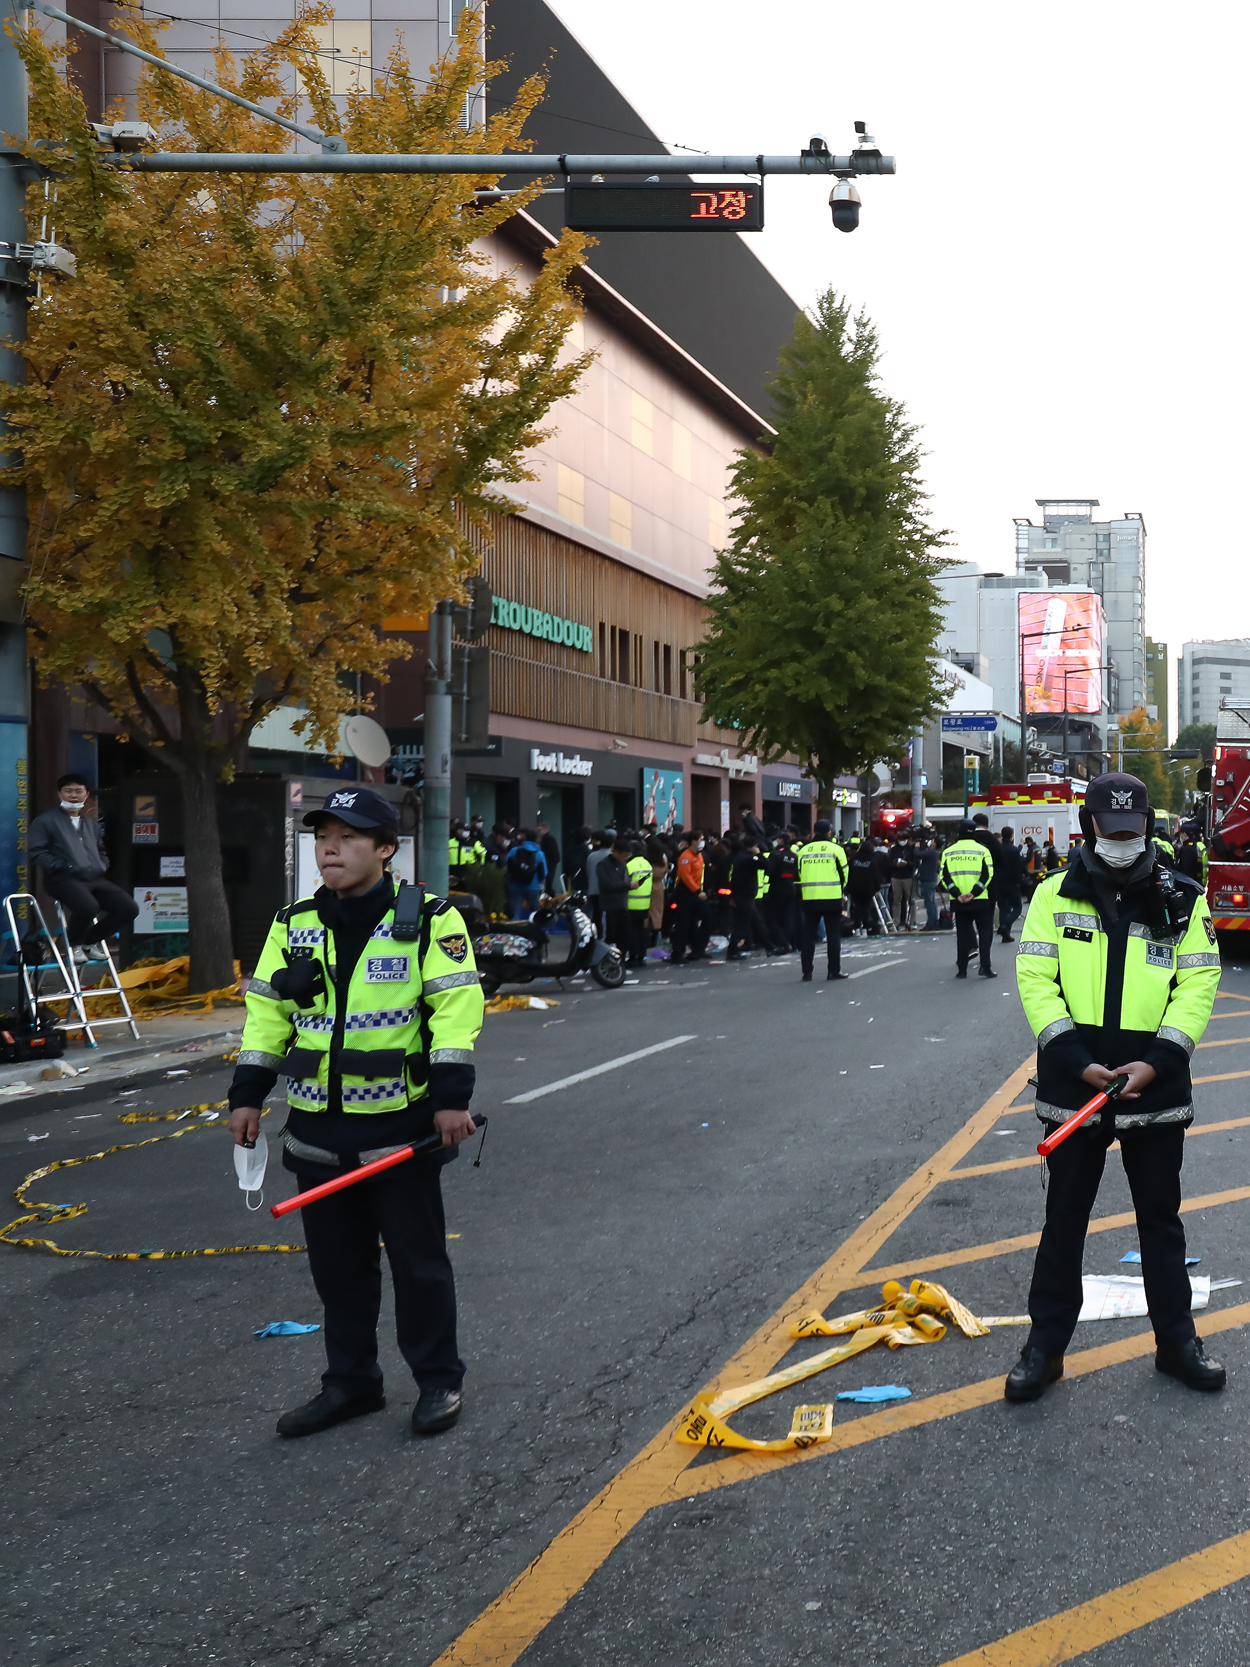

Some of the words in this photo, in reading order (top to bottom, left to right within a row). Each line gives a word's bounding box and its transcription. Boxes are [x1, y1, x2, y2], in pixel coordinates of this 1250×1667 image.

[690, 190, 754, 221] 고정
[489, 595, 593, 653] TROUBADOUR
[531, 748, 557, 773] Foot
[557, 752, 593, 776] Locker
[1021, 826, 1042, 835] ICTC
[1148, 957, 1172, 967] POLICE
[369, 972, 405, 980] POLICE
